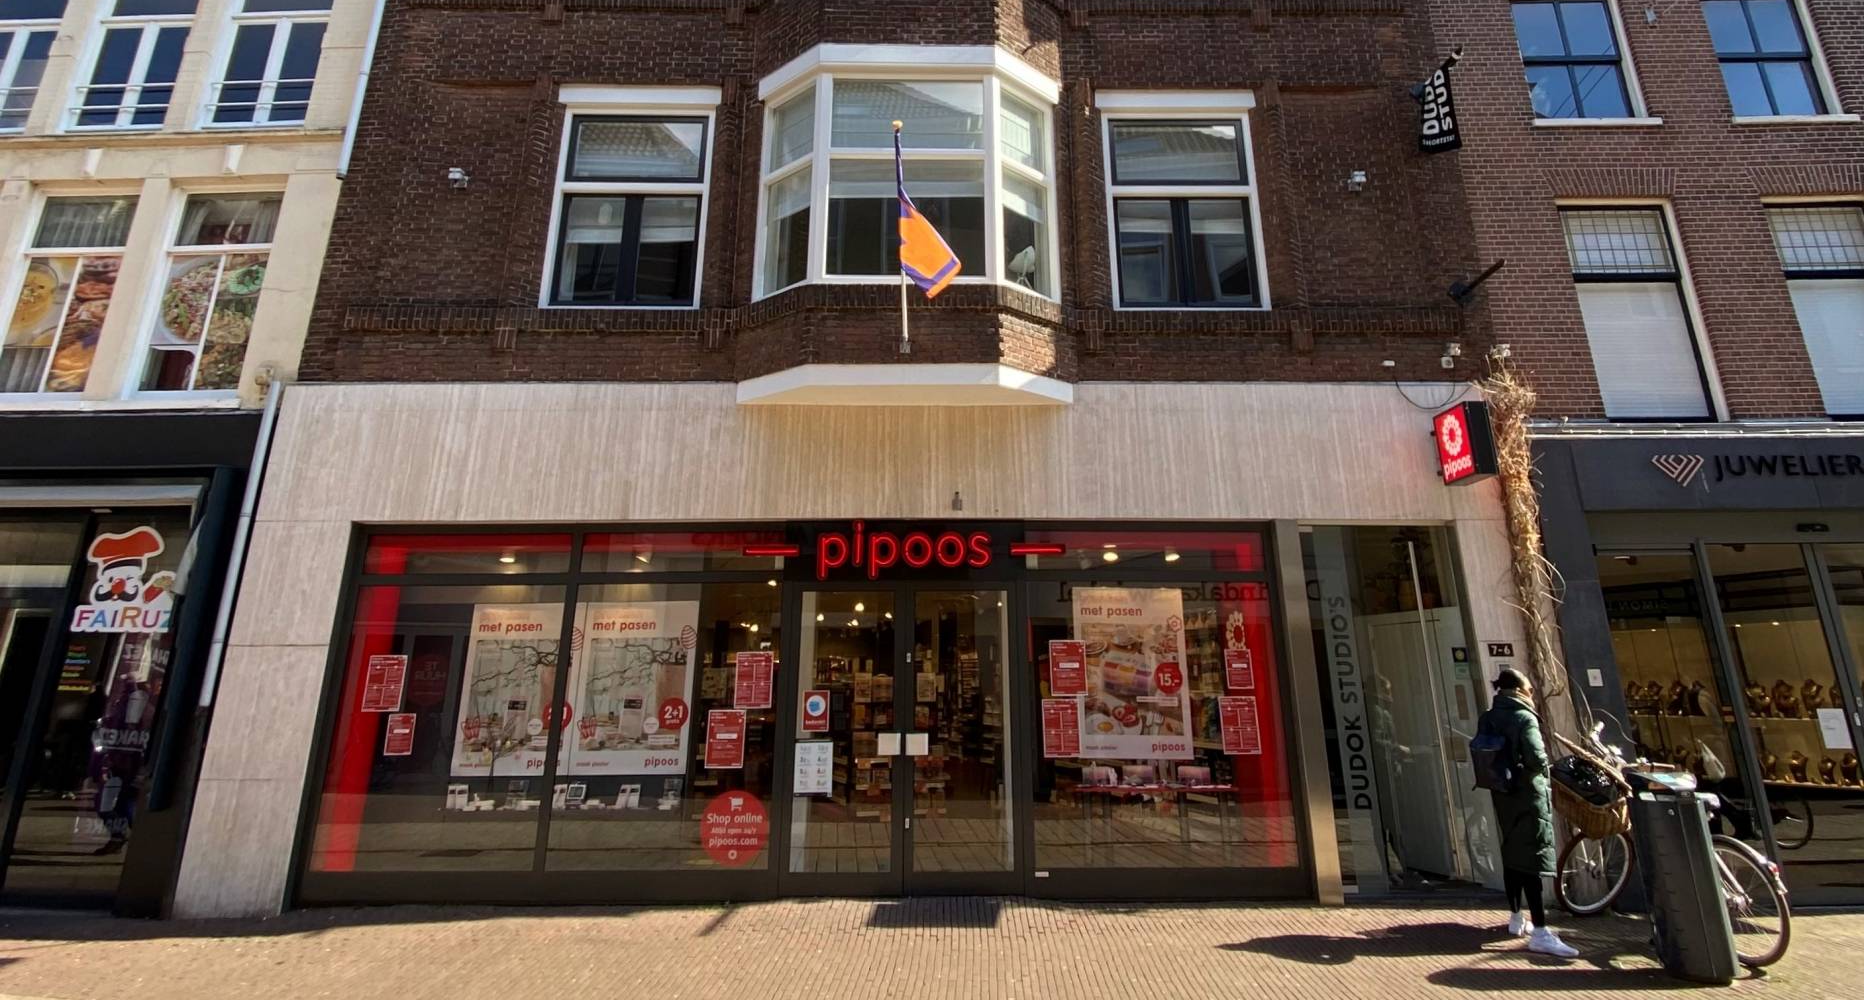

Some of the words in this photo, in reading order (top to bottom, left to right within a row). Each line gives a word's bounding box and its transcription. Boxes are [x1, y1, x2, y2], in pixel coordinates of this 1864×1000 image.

[1443, 454, 1473, 480] pipoos
[1713, 454, 1864, 482] JUWELIER
[816, 519, 993, 580] pipoos
[76, 606, 173, 628] FAIRUZ
[1080, 605, 1103, 616] met
[1106, 607, 1143, 619] pasen
[478, 622, 502, 633] met
[505, 622, 543, 635] pasen
[592, 620, 616, 631] met
[619, 621, 657, 633] pasen
[1327, 595, 1359, 704] STUDIO'S
[1490, 644, 1511, 655] 7-6
[663, 705, 684, 719] 2+1
[1151, 742, 1186, 752] pipoos
[644, 756, 679, 768] pipoos
[1344, 714, 1373, 811] DUDOK
[706, 812, 731, 825] Shop
[734, 812, 763, 824] online
[708, 836, 758, 849] pipoos.com
